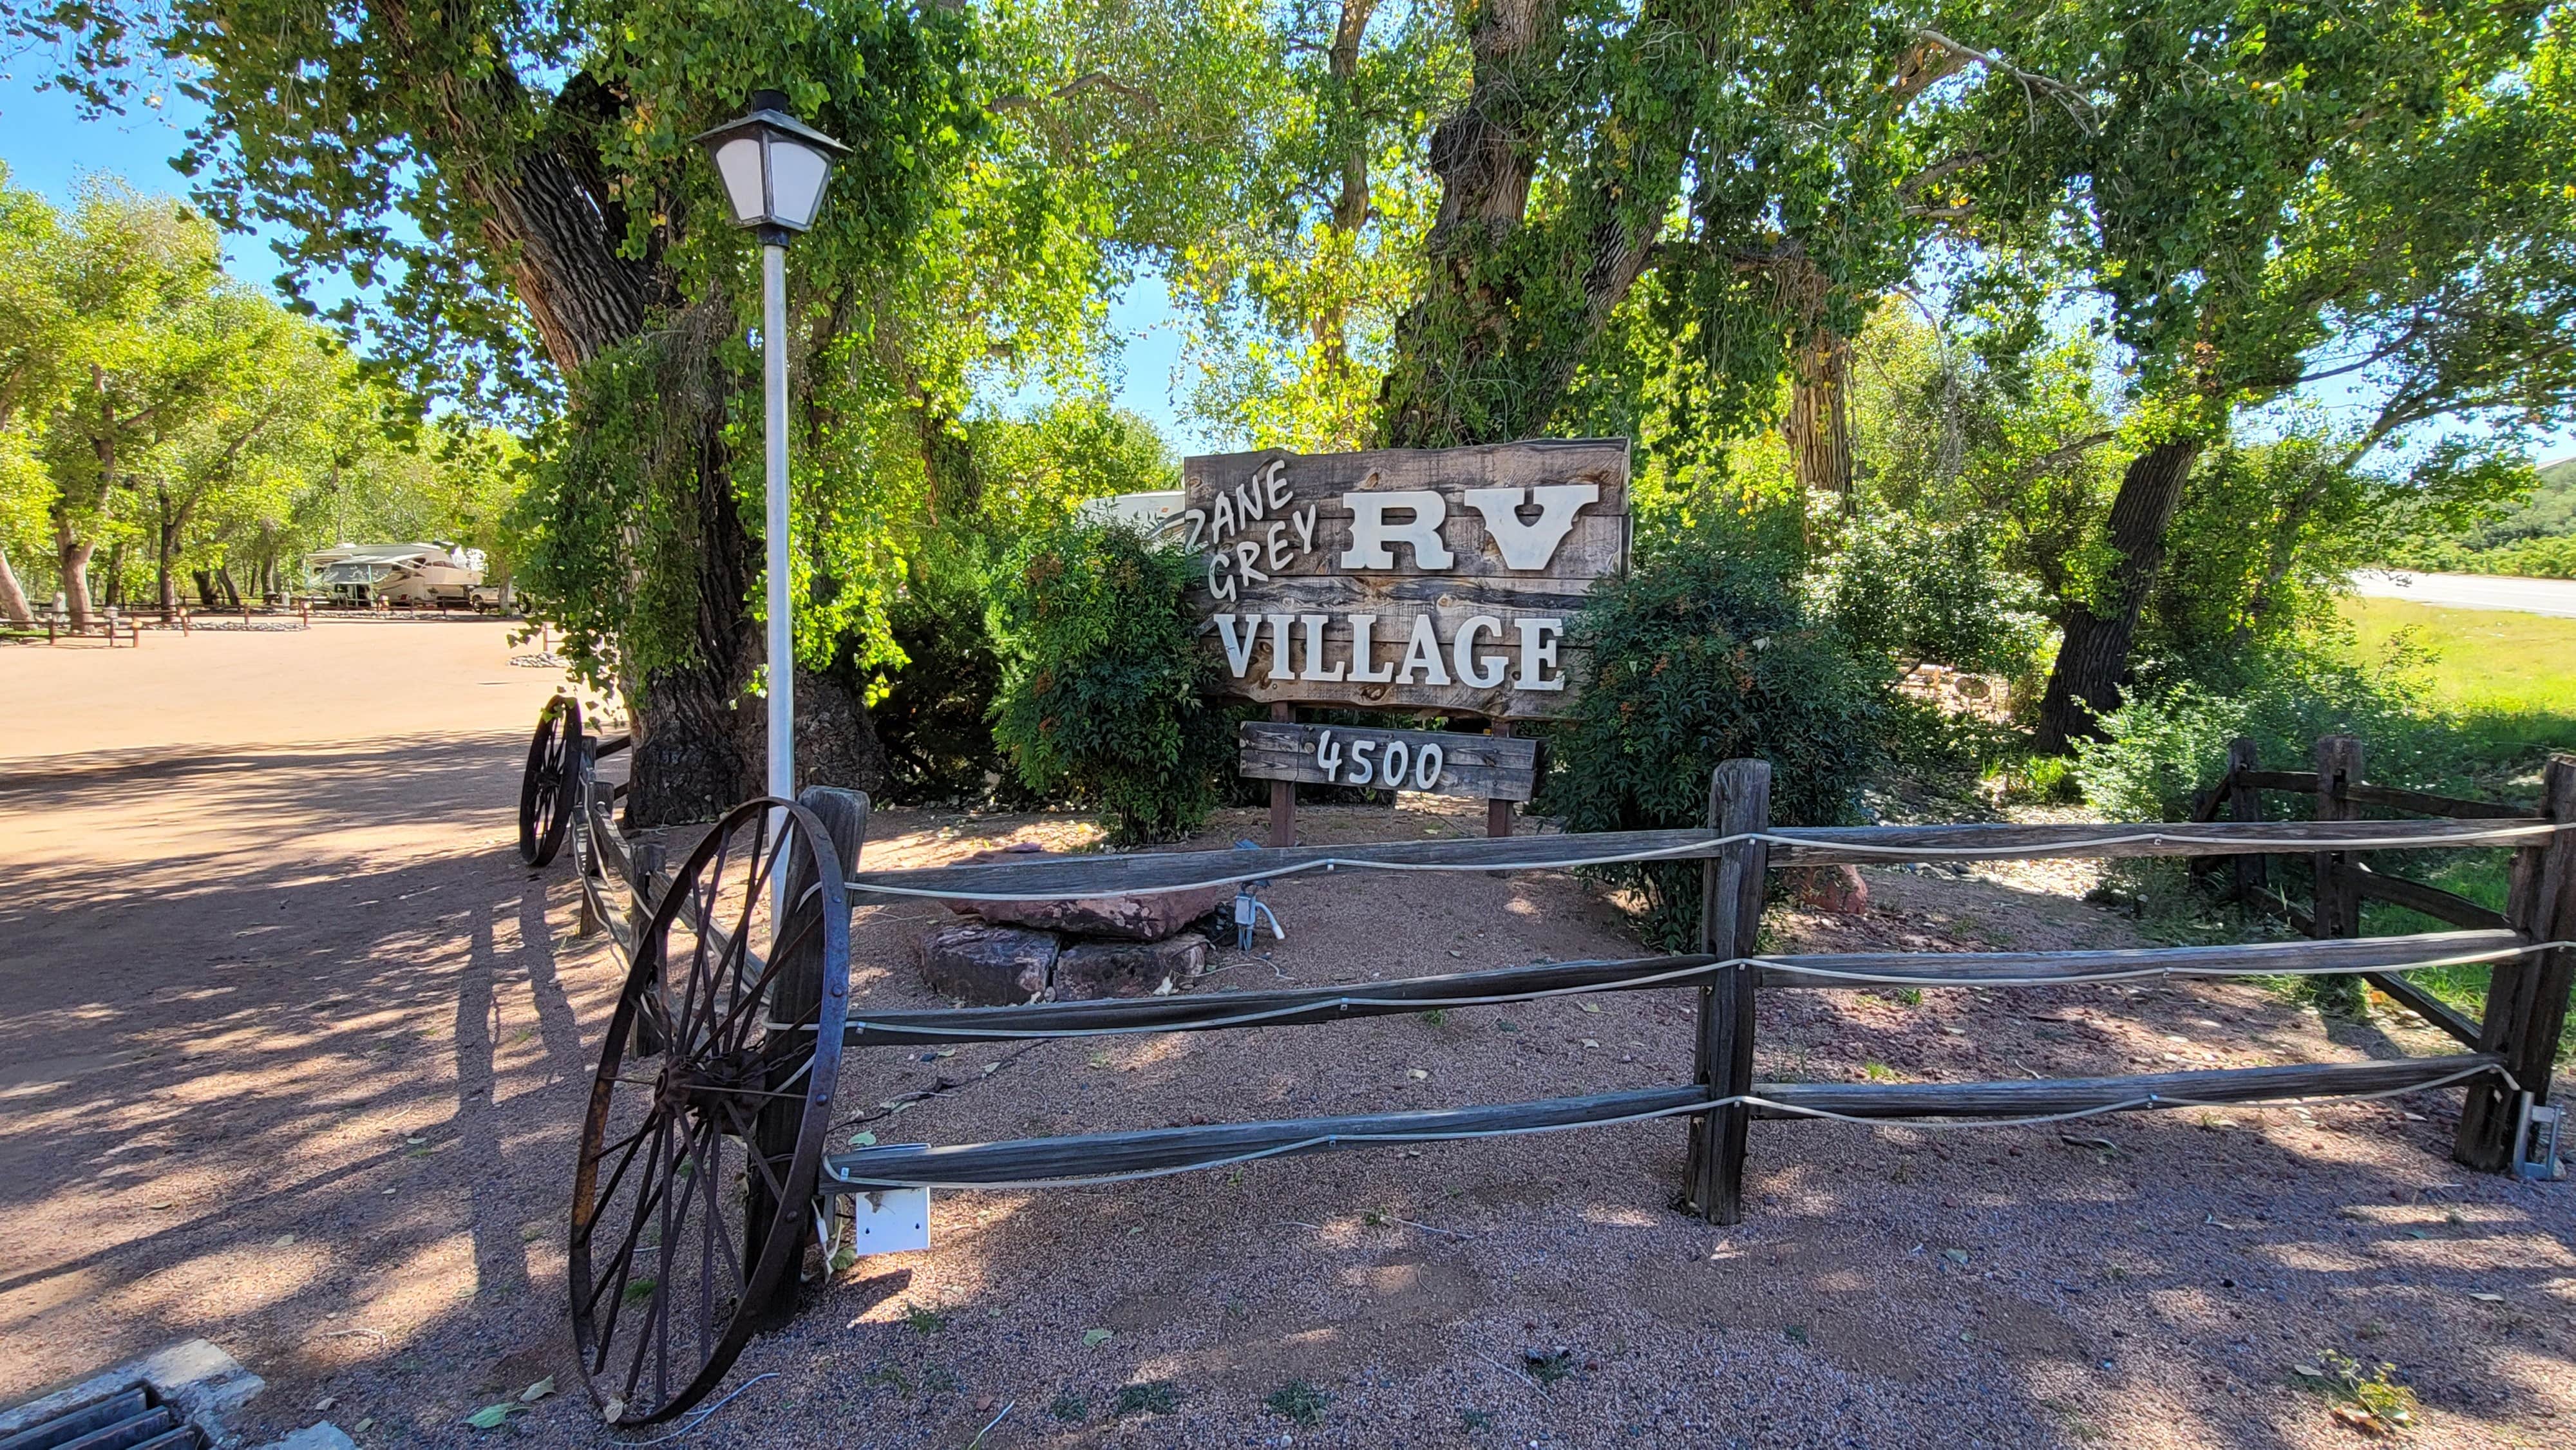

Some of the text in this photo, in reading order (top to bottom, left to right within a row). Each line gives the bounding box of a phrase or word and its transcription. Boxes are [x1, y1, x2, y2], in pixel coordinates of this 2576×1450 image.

[1185, 460, 1293, 555] ZANE
[1341, 484, 1599, 570] RV
[1208, 504, 1316, 602] GREY
[1213, 614, 1566, 691] VILLAGE
[1318, 730, 1444, 790] 4500
